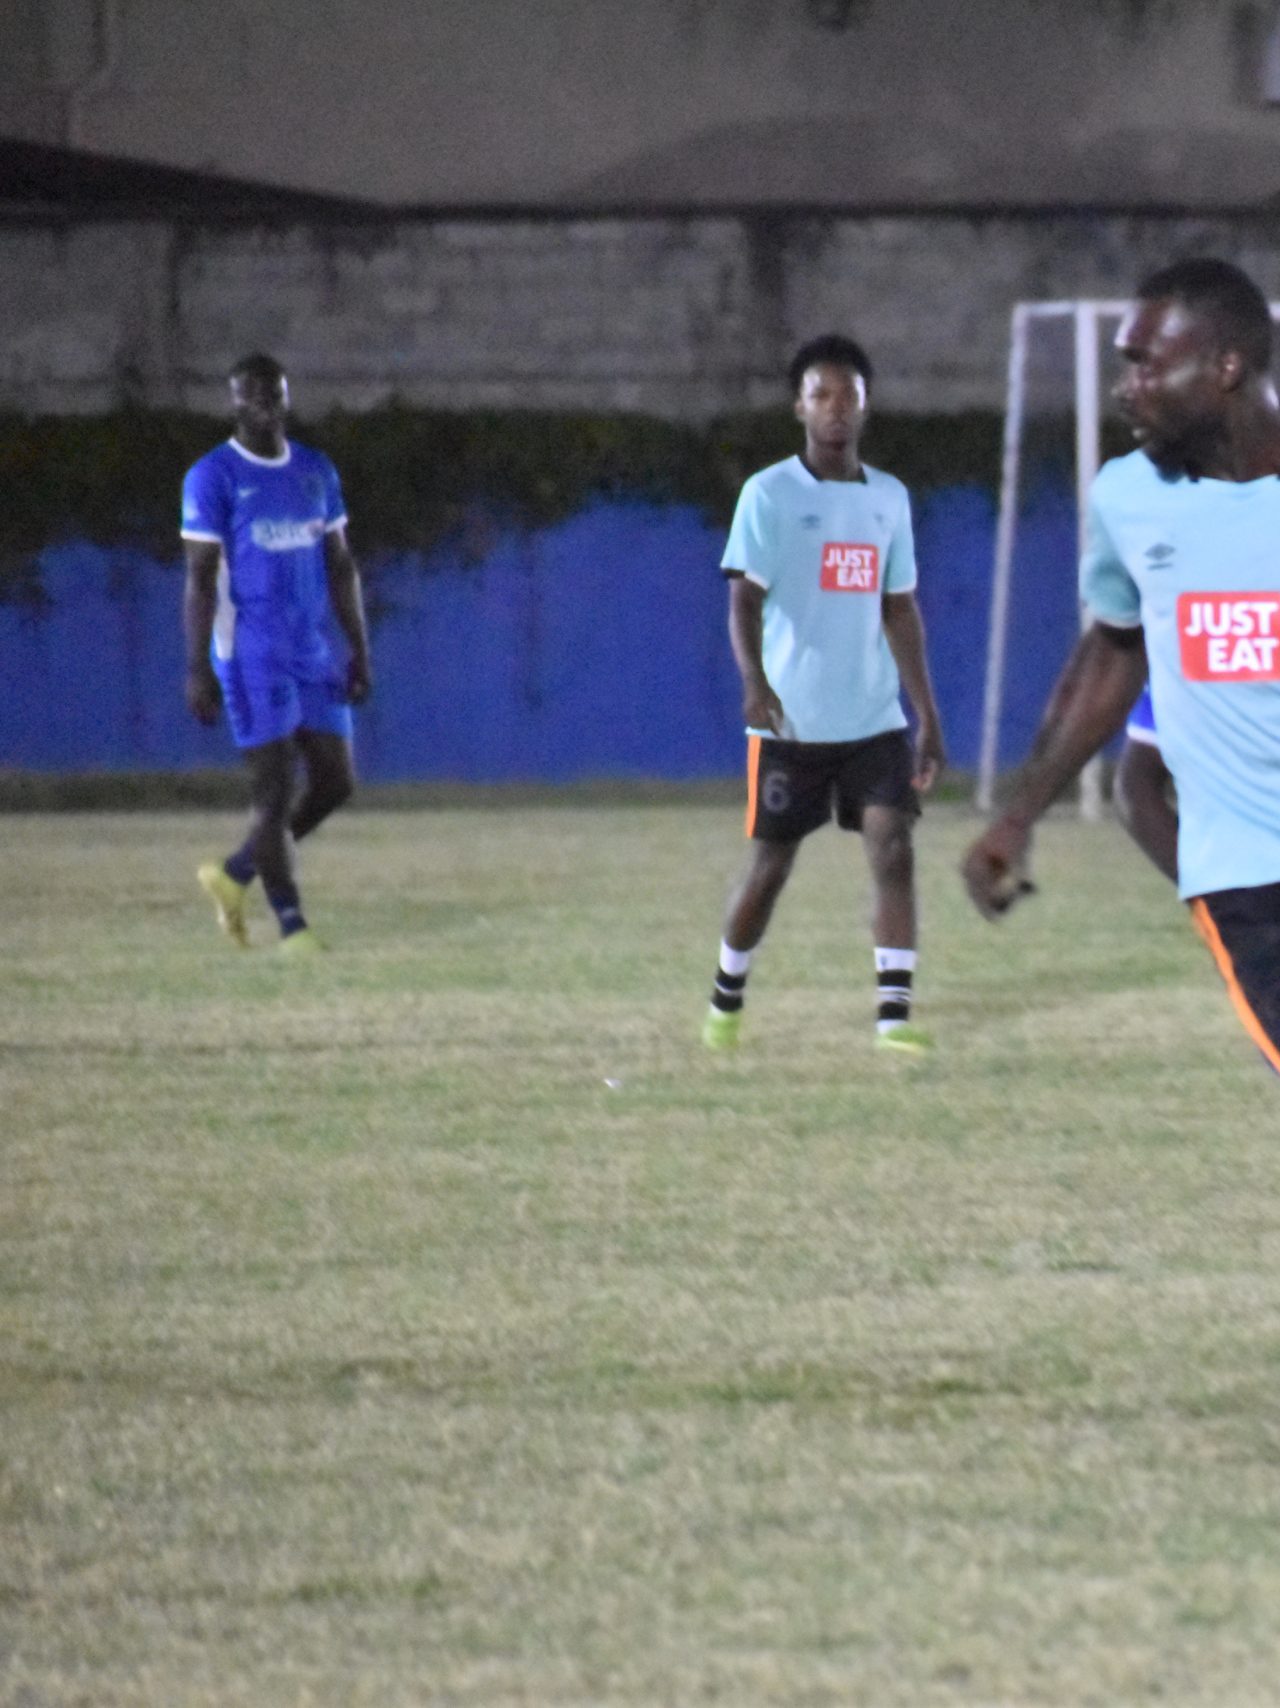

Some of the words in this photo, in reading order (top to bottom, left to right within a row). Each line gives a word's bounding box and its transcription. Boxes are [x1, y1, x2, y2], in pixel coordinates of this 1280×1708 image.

[824, 549, 873, 568] JUST
[837, 567, 873, 587] EAT
[1184, 602, 1279, 636] JUST
[1208, 637, 1280, 672] EAT
[763, 770, 790, 812] 6
